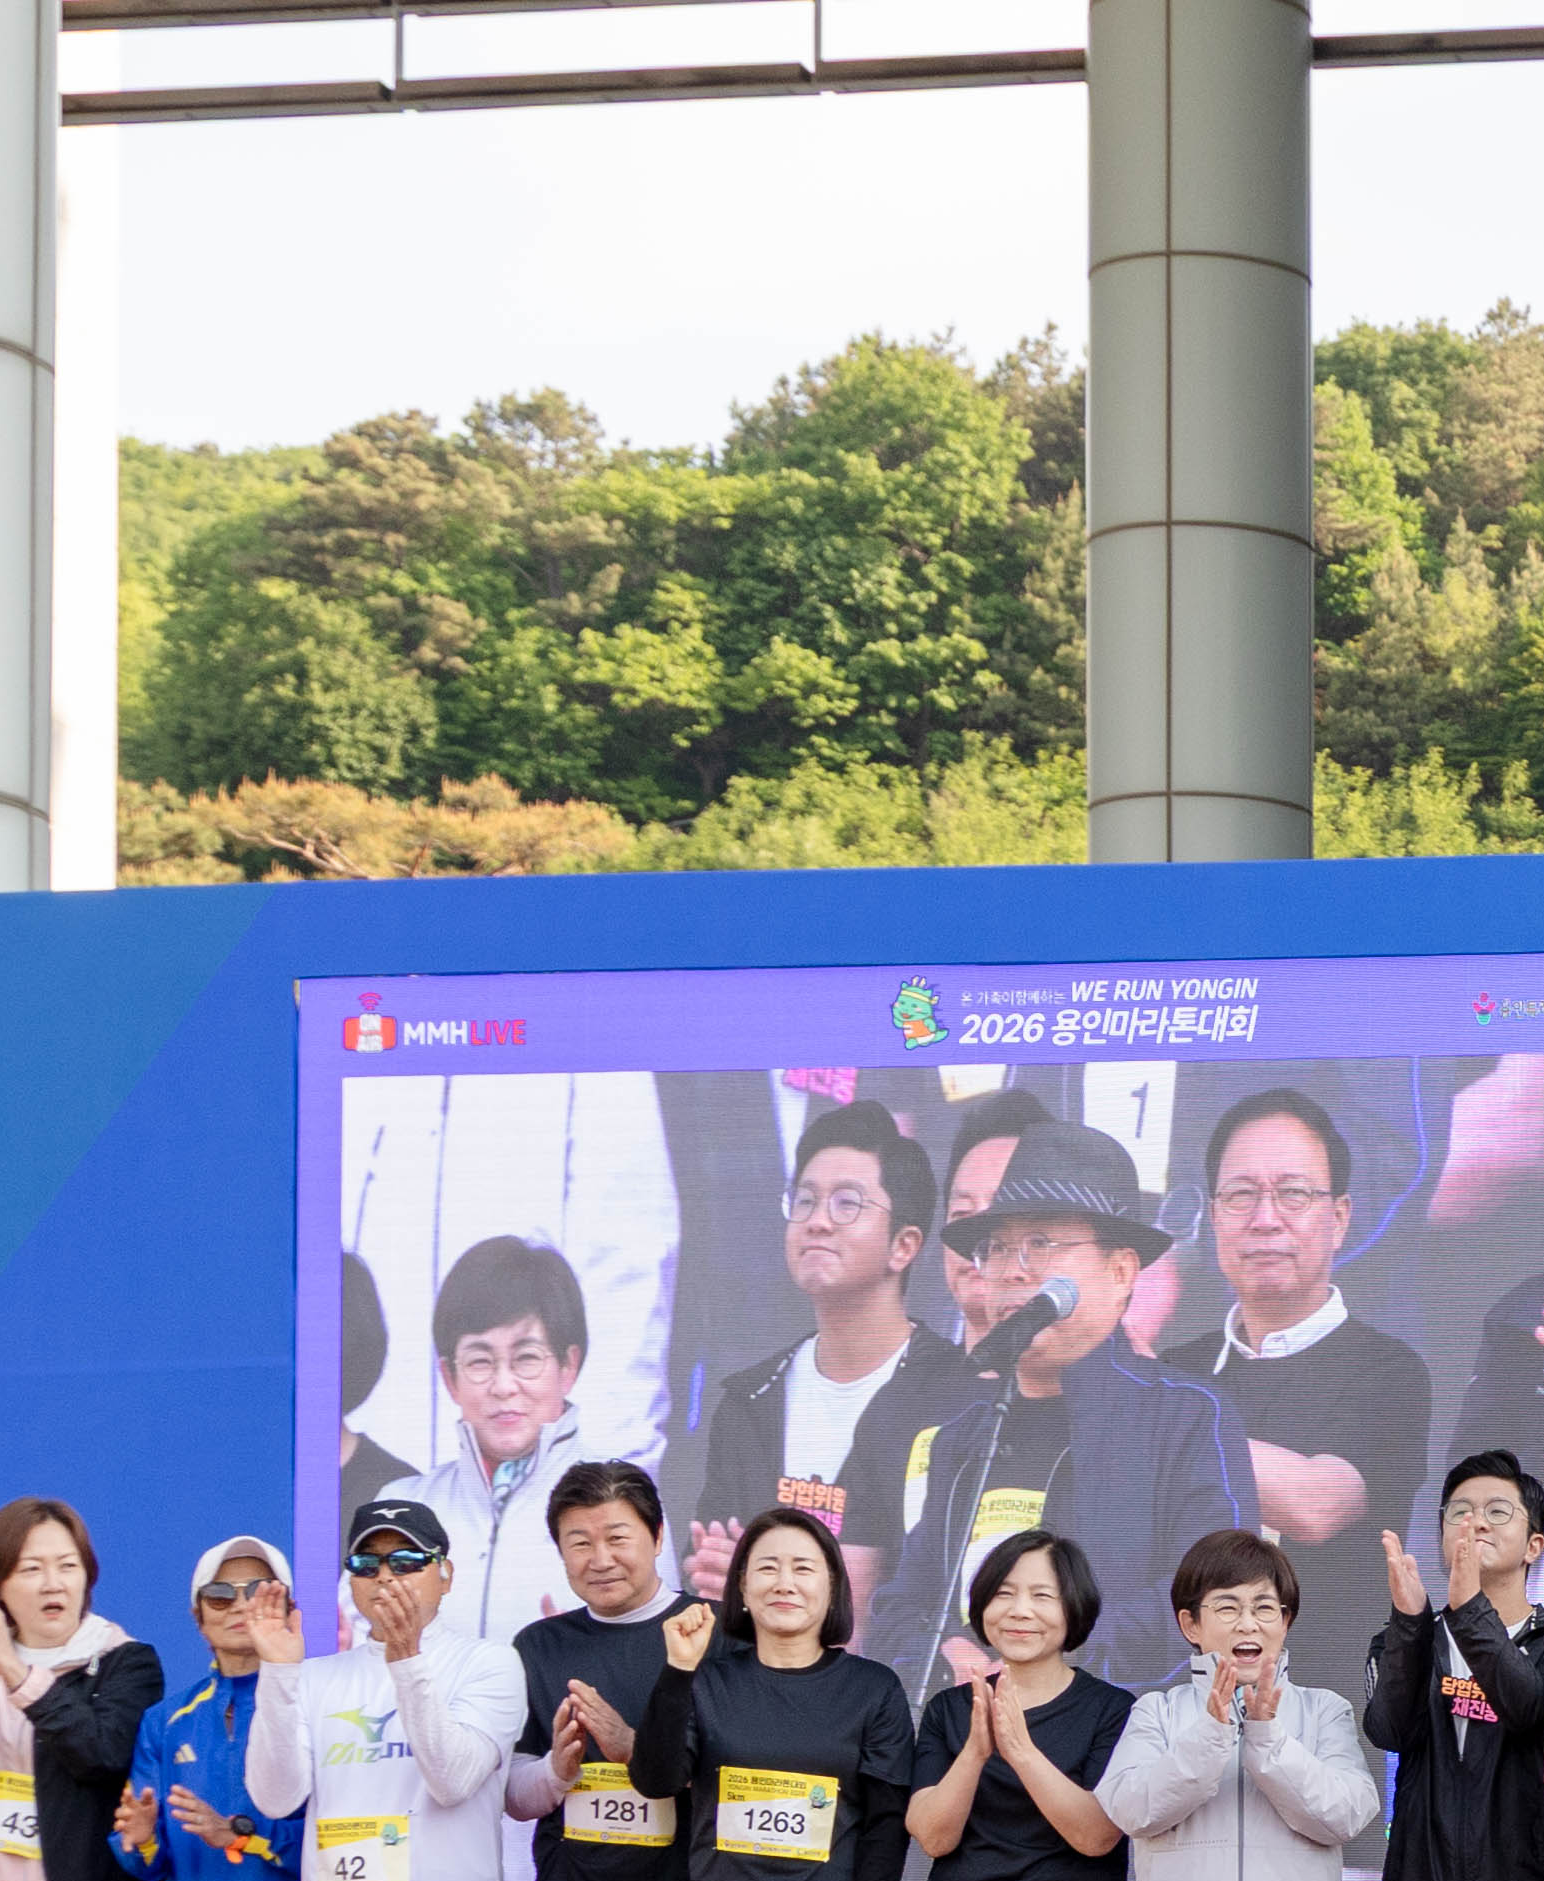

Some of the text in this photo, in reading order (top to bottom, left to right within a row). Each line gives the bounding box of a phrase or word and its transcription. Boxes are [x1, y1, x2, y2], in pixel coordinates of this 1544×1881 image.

[1071, 981, 1107, 1002] WE
[1114, 979, 1162, 1000] RUN
[1171, 977, 1259, 1000] YONGIN
[959, 1004, 1259, 1046] 2026 용인마라톤대회
[590, 1797, 649, 1823] 1281
[744, 1808, 806, 1835] 1263
[2, 1811, 40, 1839] 43
[335, 1856, 366, 1880] 42
